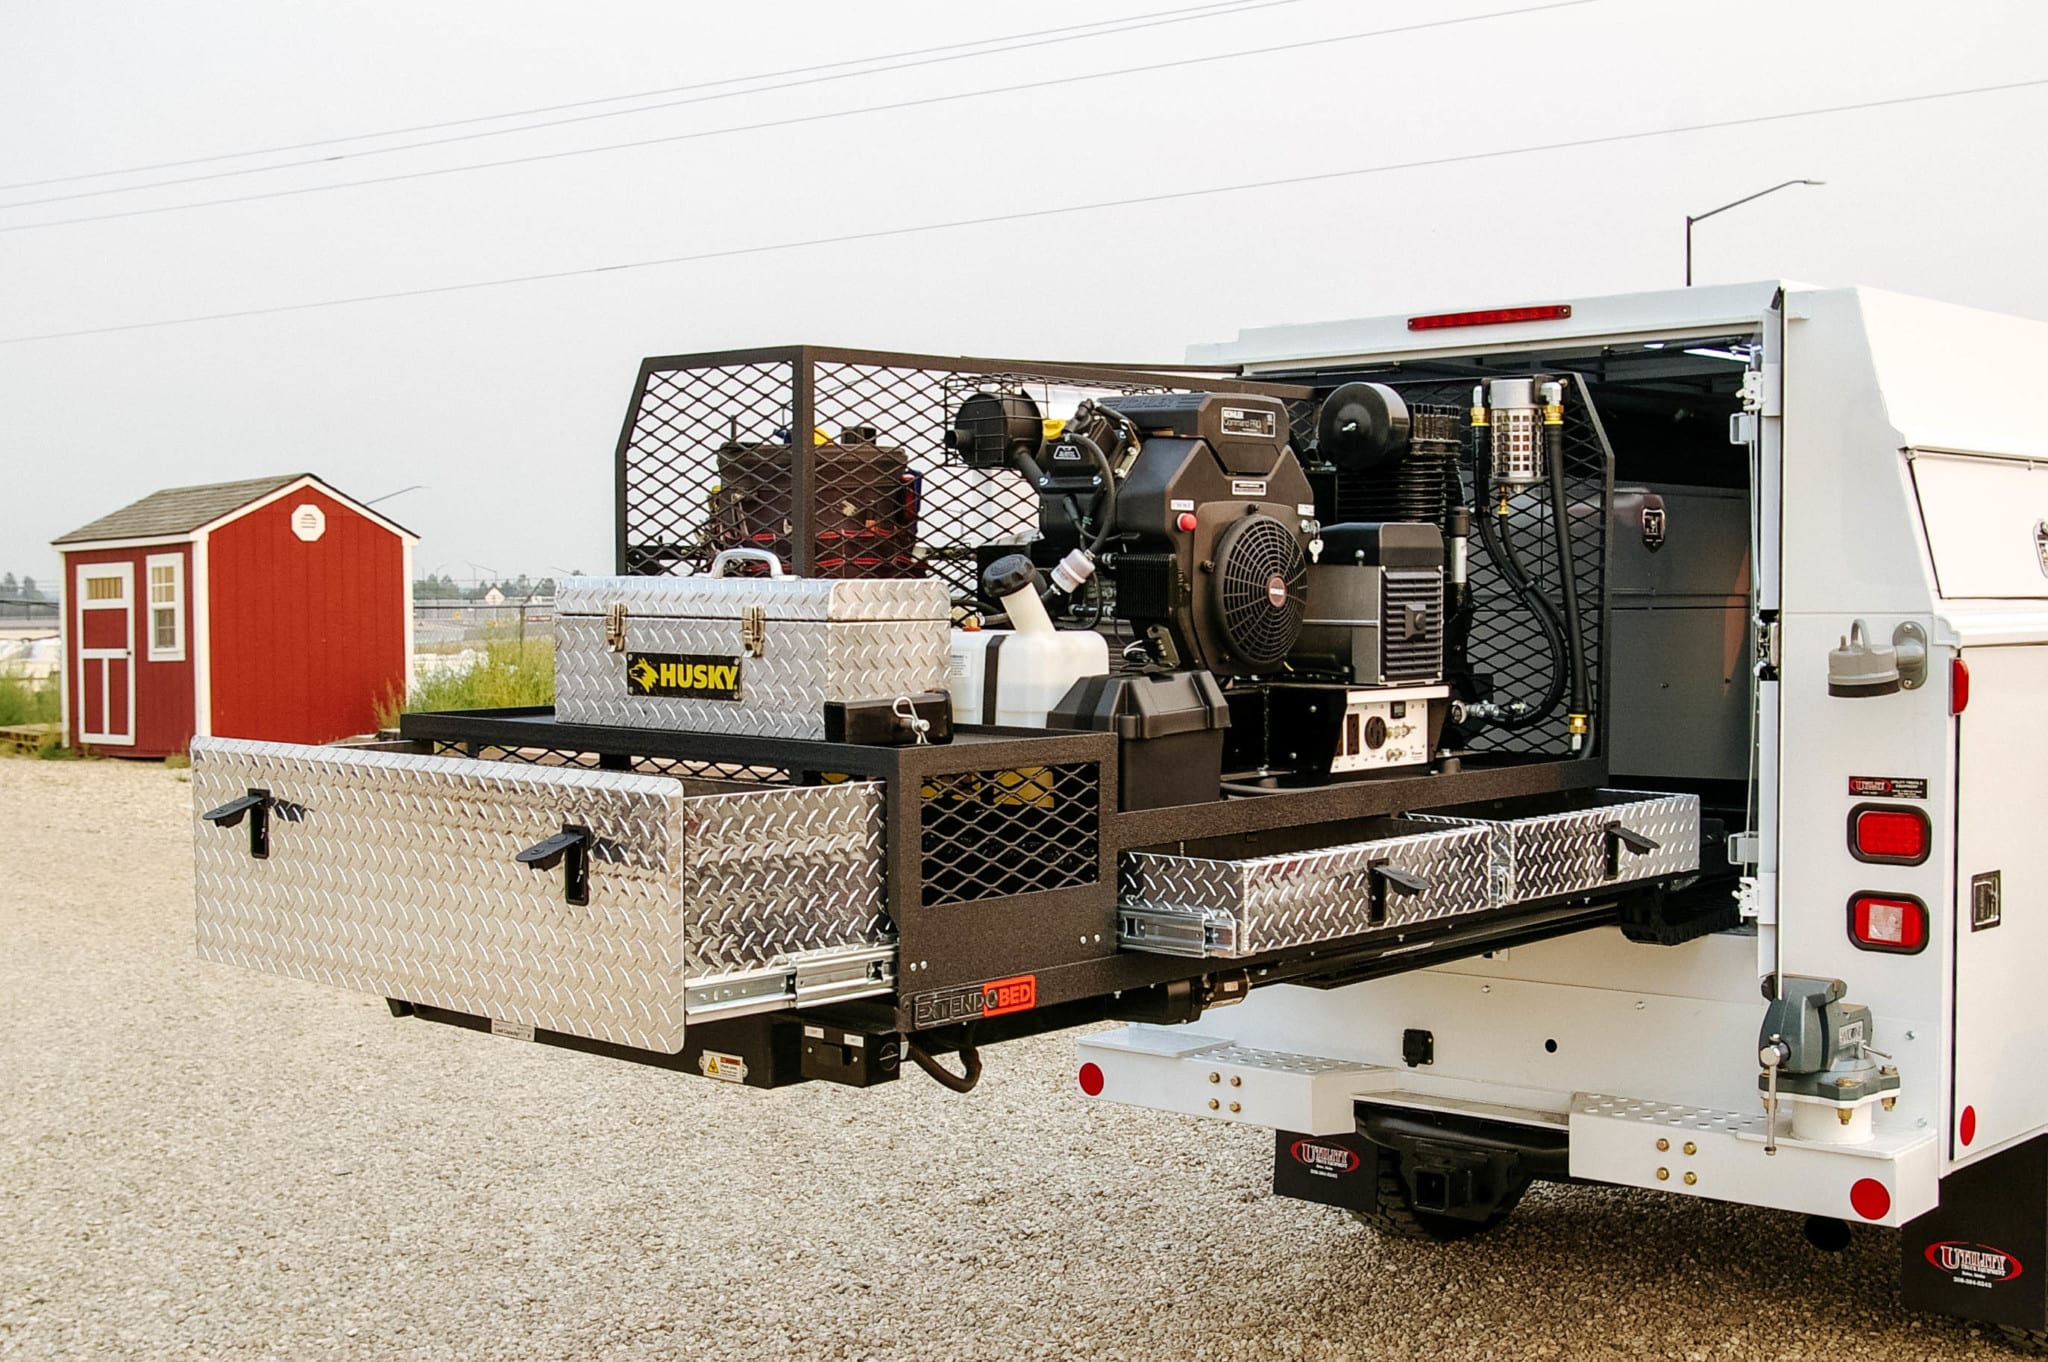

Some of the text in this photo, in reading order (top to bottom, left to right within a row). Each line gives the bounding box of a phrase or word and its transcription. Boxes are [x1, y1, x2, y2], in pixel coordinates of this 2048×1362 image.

[659, 663, 739, 690] HUSKY
[1302, 1144, 1348, 1163] UTILITY
[1940, 1246, 2006, 1270] UTILITY
